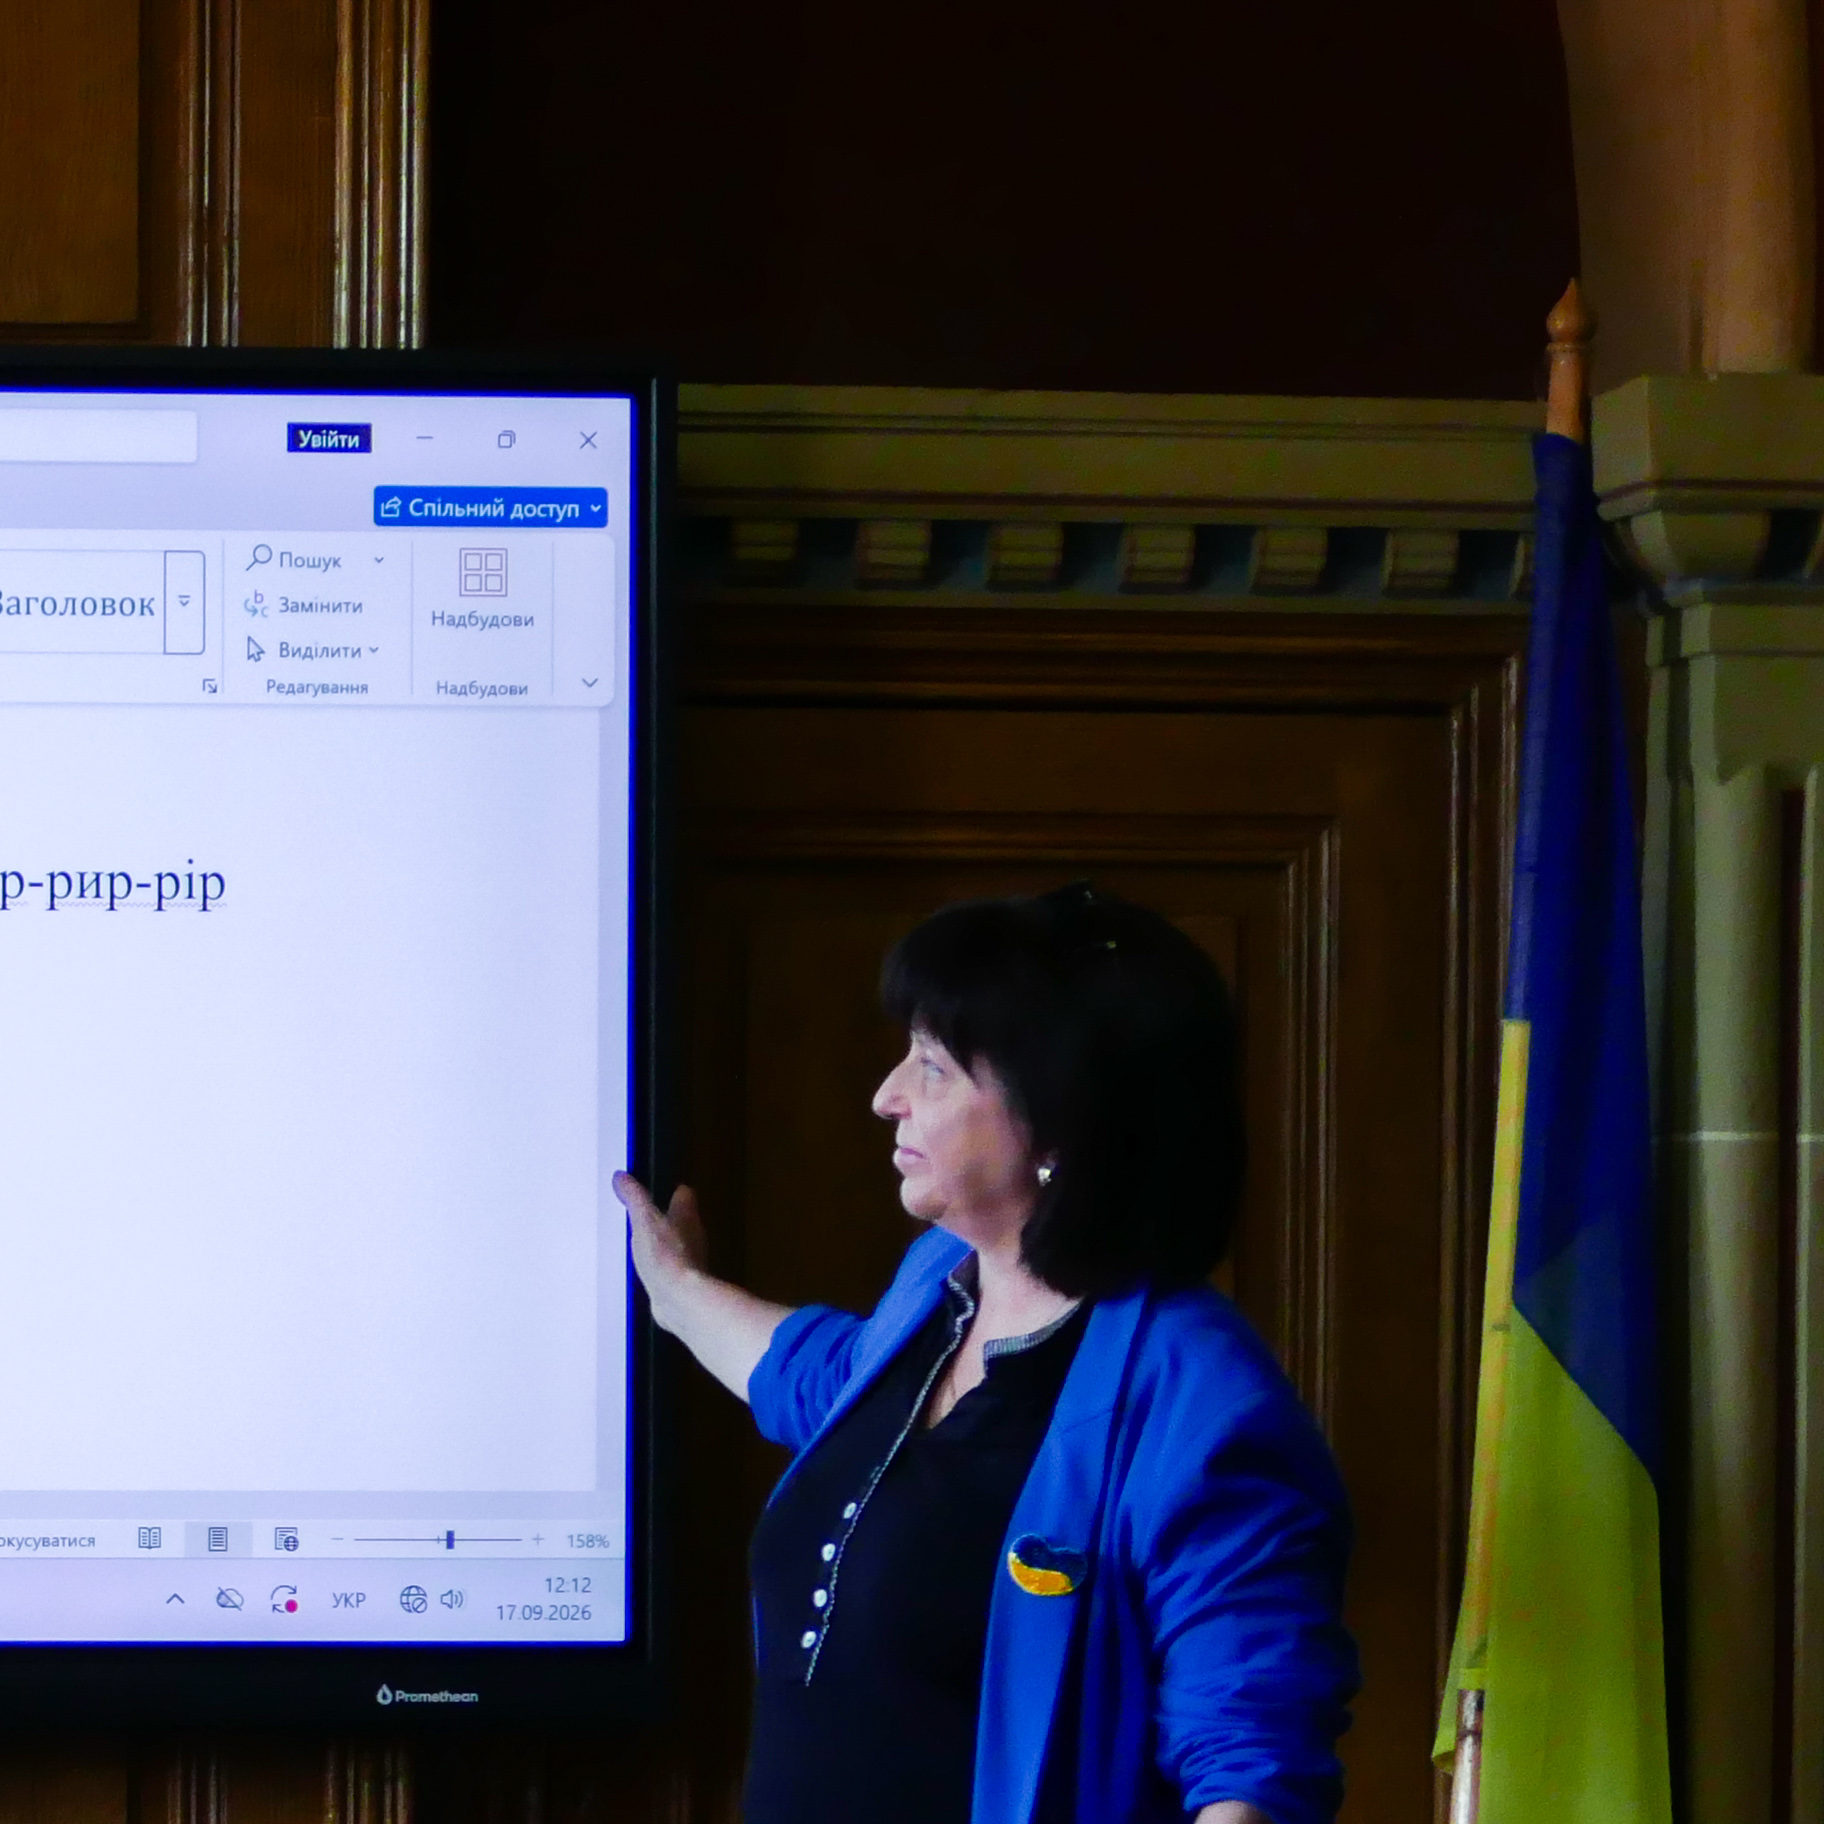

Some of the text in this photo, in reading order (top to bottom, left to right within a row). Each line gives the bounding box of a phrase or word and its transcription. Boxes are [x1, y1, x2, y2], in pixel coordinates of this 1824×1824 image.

[297, 428, 362, 451] Увійти
[408, 497, 581, 523] Спільний доступ
[278, 550, 342, 574] Пошук
[278, 595, 363, 614] Замінити
[431, 609, 535, 632] Надбудови
[278, 640, 362, 661] Виділити
[265, 678, 369, 698] Редагування
[435, 679, 529, 700] Надбудови
[565, 1532, 611, 1552] 158%
[544, 1575, 592, 1595] 12:12
[332, 1591, 367, 1609] УКР
[496, 1603, 593, 1622] 17.09.2026
[395, 1691, 479, 1703] Promethean
